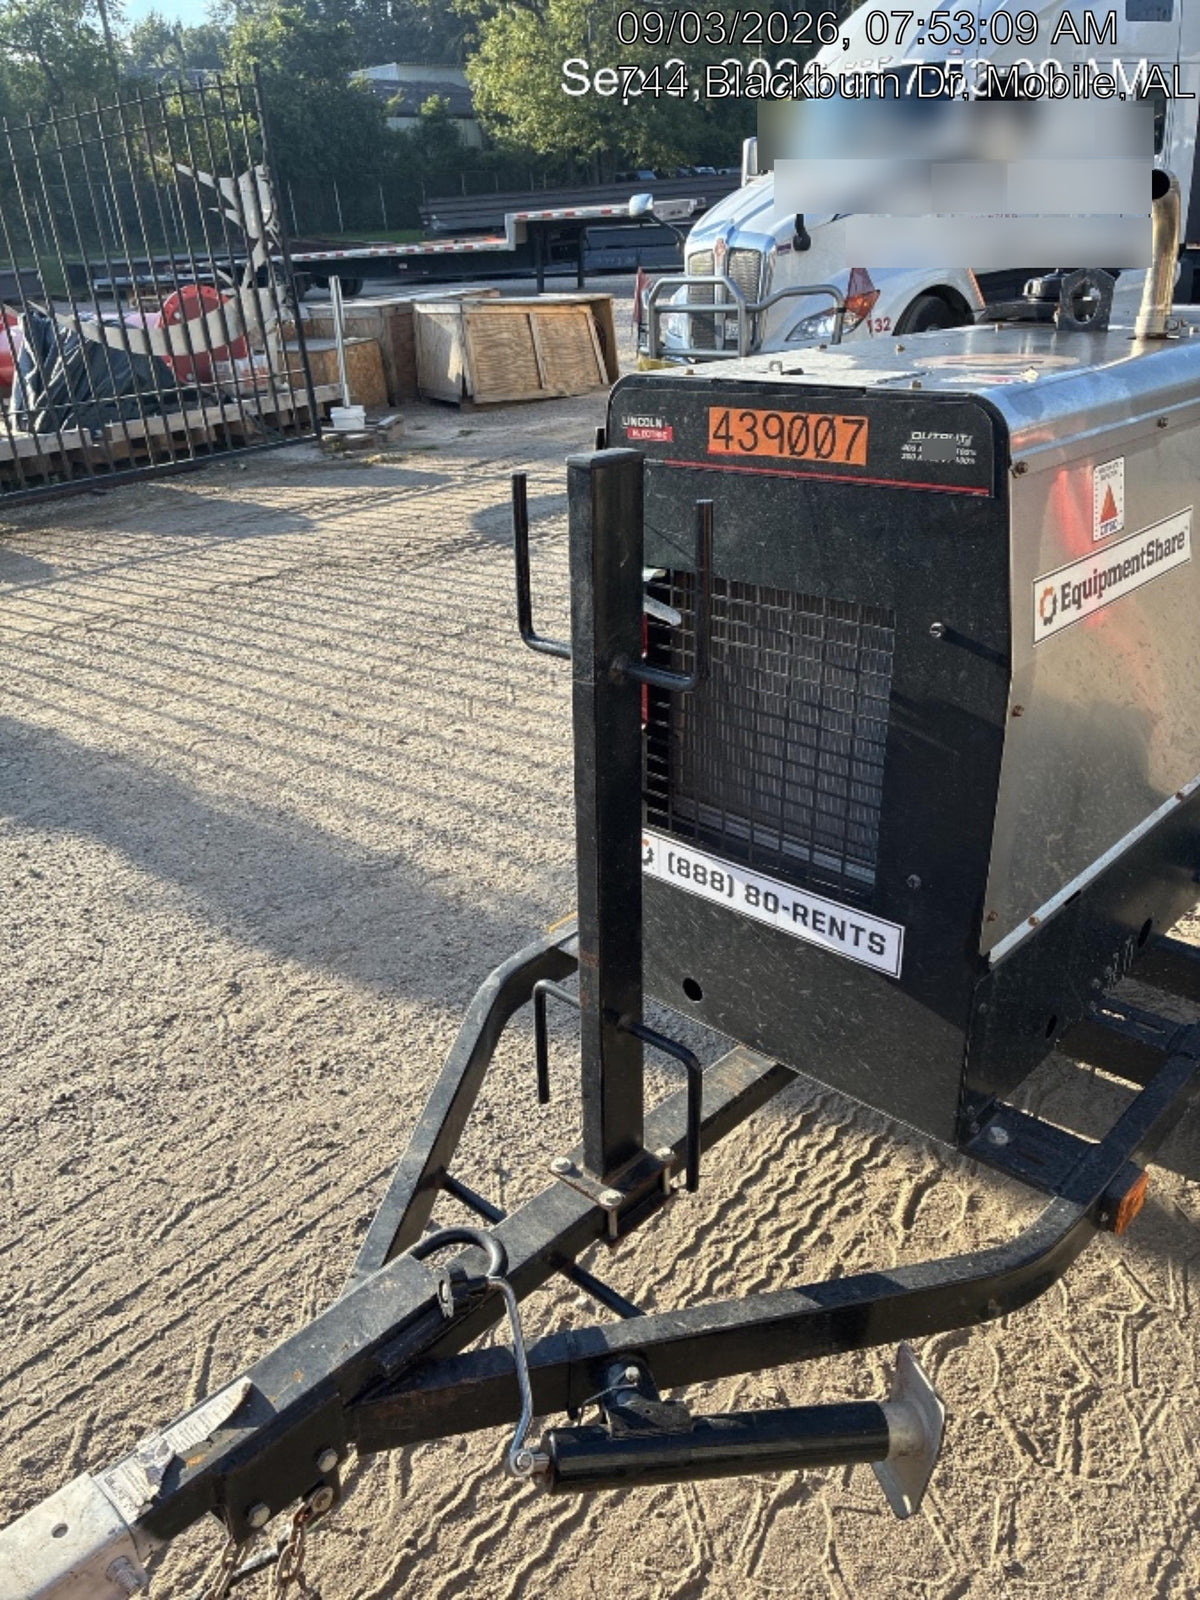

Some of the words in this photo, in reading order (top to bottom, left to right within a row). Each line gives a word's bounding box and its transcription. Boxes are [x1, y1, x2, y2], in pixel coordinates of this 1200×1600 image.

[621, 415, 663, 428] LINCOLN
[712, 410, 866, 462] 439007
[1061, 531, 1186, 613] EquipmentShare
[667, 851, 735, 899] (888)
[744, 884, 887, 956] 80-RENTS
